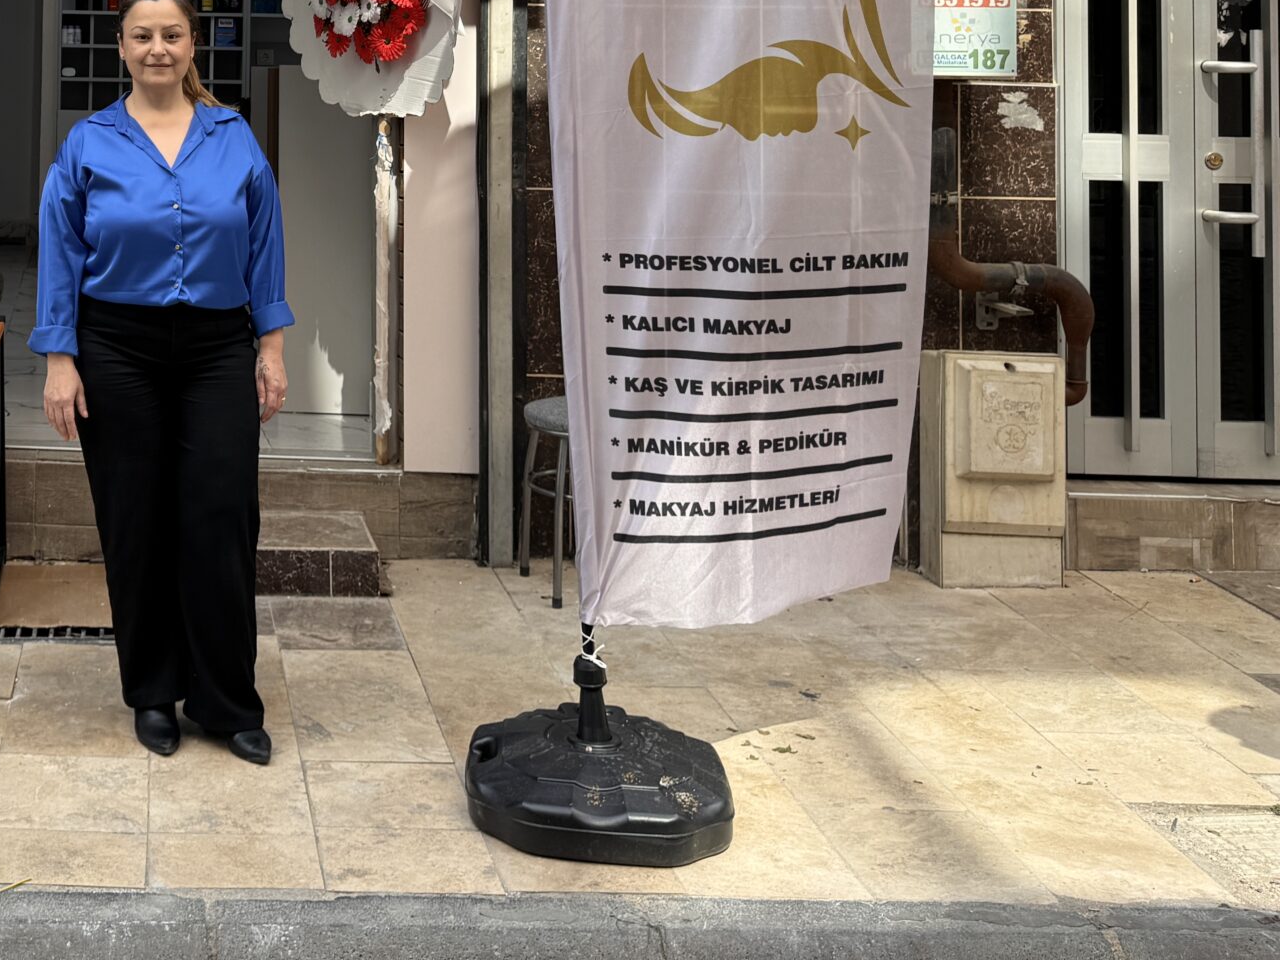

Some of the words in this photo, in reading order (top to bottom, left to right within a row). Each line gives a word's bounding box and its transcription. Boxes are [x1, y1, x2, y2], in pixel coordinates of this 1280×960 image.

[939, 33, 1001, 47] nerya
[968, 48, 1010, 70] 187
[619, 253, 783, 274] PROFESYONEL
[789, 252, 836, 272] CİLT
[841, 252, 909, 270] BAKIM
[622, 314, 695, 332] KALICI
[703, 318, 791, 335] MAKYAJ
[624, 376, 668, 397] KAŞ
[675, 379, 703, 395] VE
[711, 375, 785, 397] KİRPİK
[790, 369, 884, 391] TASARIMI
[627, 435, 730, 457] MANİKÜR
[736, 440, 751, 455] &
[759, 430, 847, 454] PEDİKÜR
[629, 499, 716, 517] MAKYAJ
[724, 486, 840, 515] HİZMETLERİ
